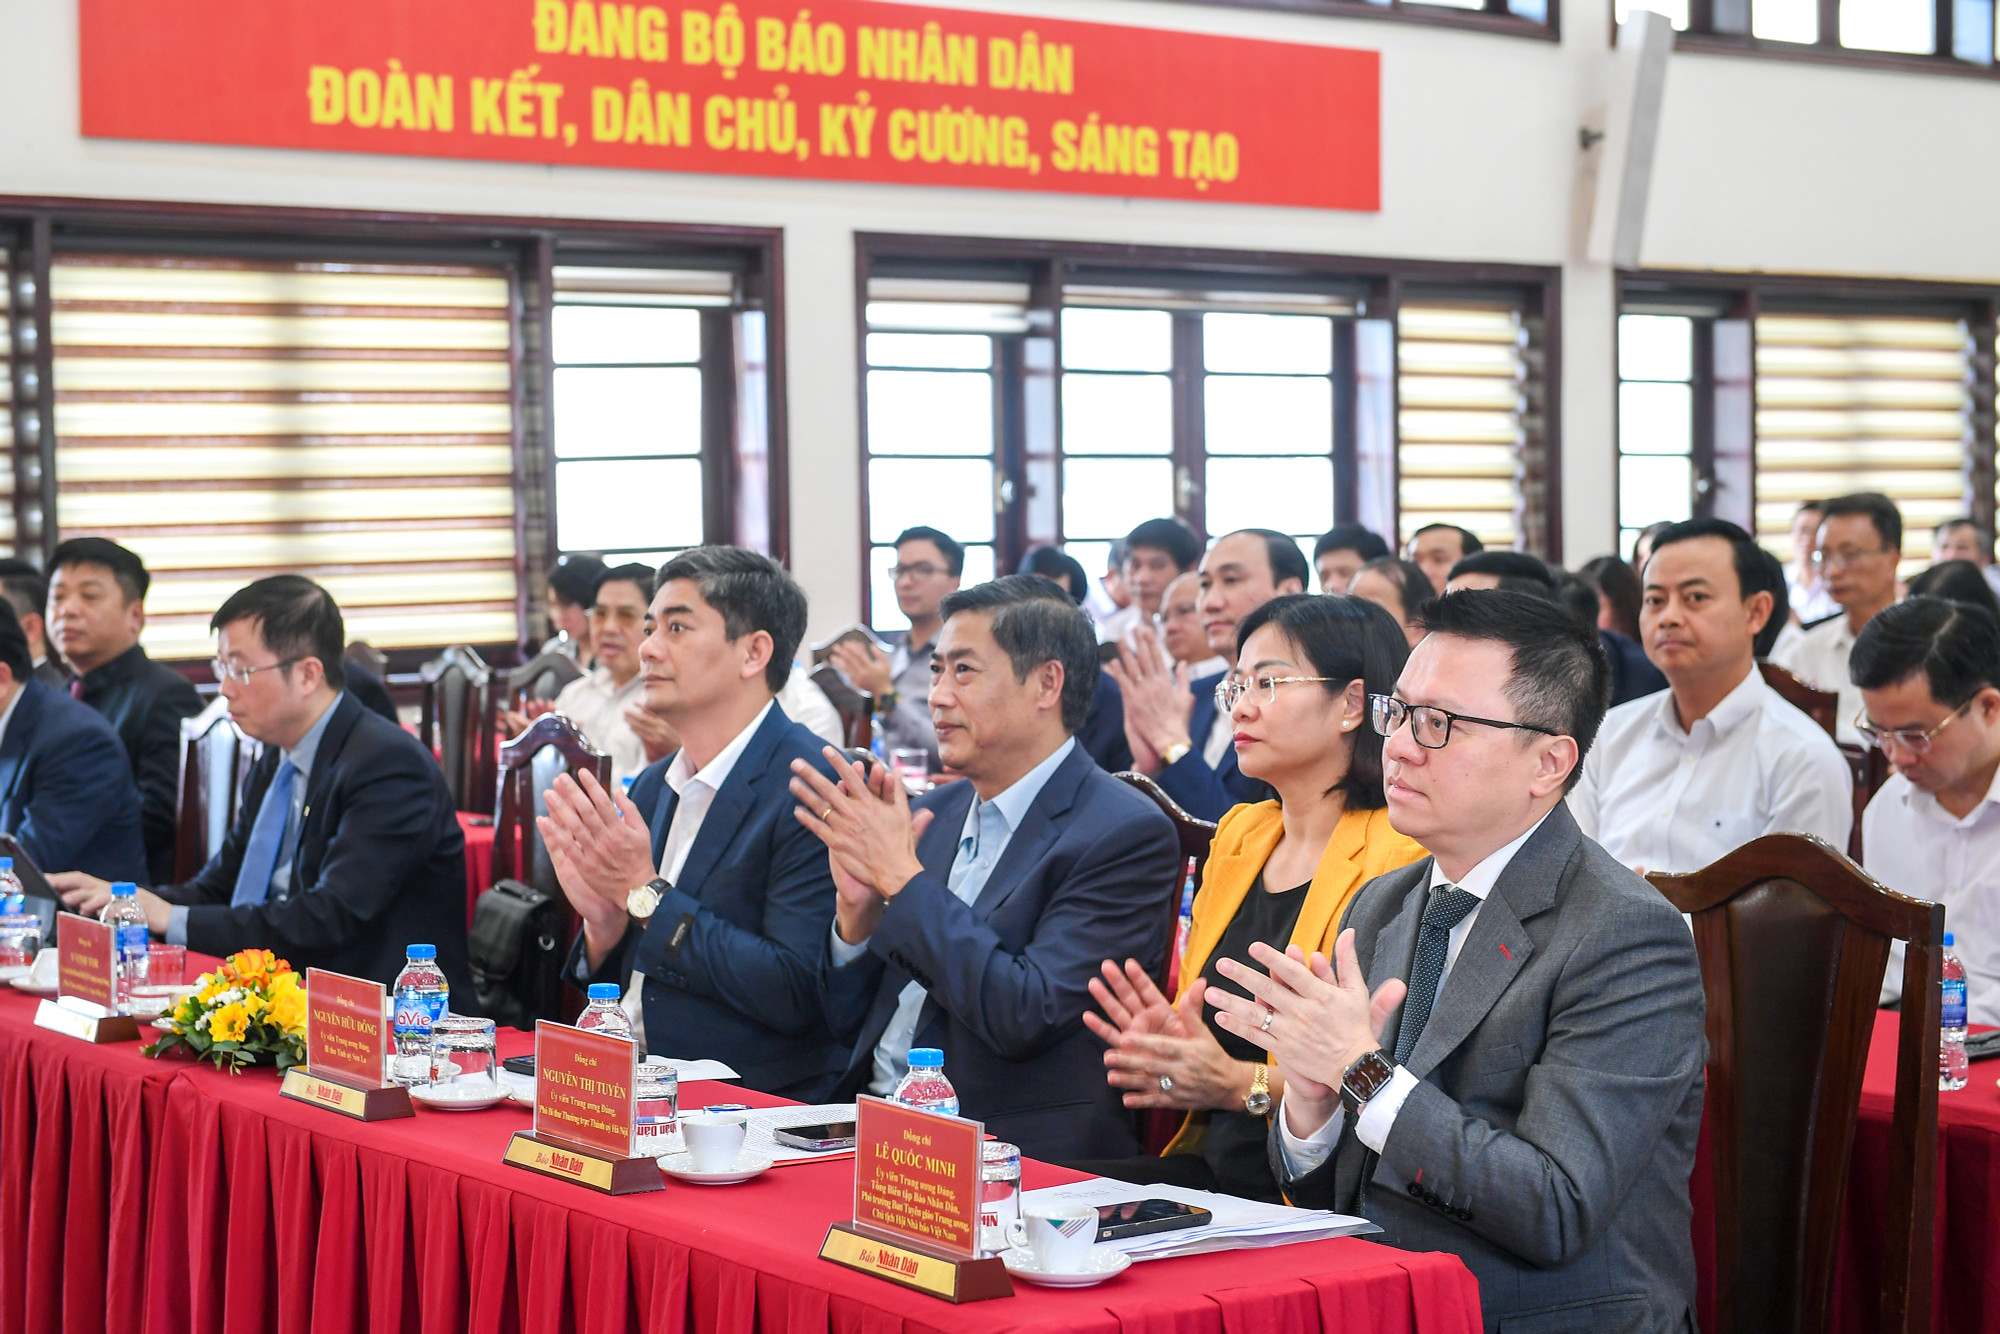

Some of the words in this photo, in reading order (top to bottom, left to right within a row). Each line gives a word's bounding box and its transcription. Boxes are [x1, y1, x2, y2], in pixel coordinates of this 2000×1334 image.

[681, 2, 746, 80] BỘ
[756, 8, 846, 77] BÁO
[857, 20, 979, 88] NHÂN
[988, 29, 1075, 95] DÂN
[307, 57, 454, 132] ĐOÀN
[470, 63, 578, 147] KẾT,
[591, 77, 692, 148] DÂN
[704, 83, 810, 161] CHỦ,
[819, 89, 878, 159] KỶ
[887, 104, 1042, 175] CƯƠNG,
[1050, 111, 1160, 178] SÁNG
[1167, 129, 1240, 192] TẠO
[579, 1076, 595, 1096] THỊ
[875, 1140, 890, 1160] LÊ
[925, 1156, 957, 1178] MINH
[900, 1173, 920, 1190] Trung
[858, 1248, 875, 1264] Báo
[876, 1248, 901, 1270] Nhân
[900, 1256, 920, 1275] Dân
